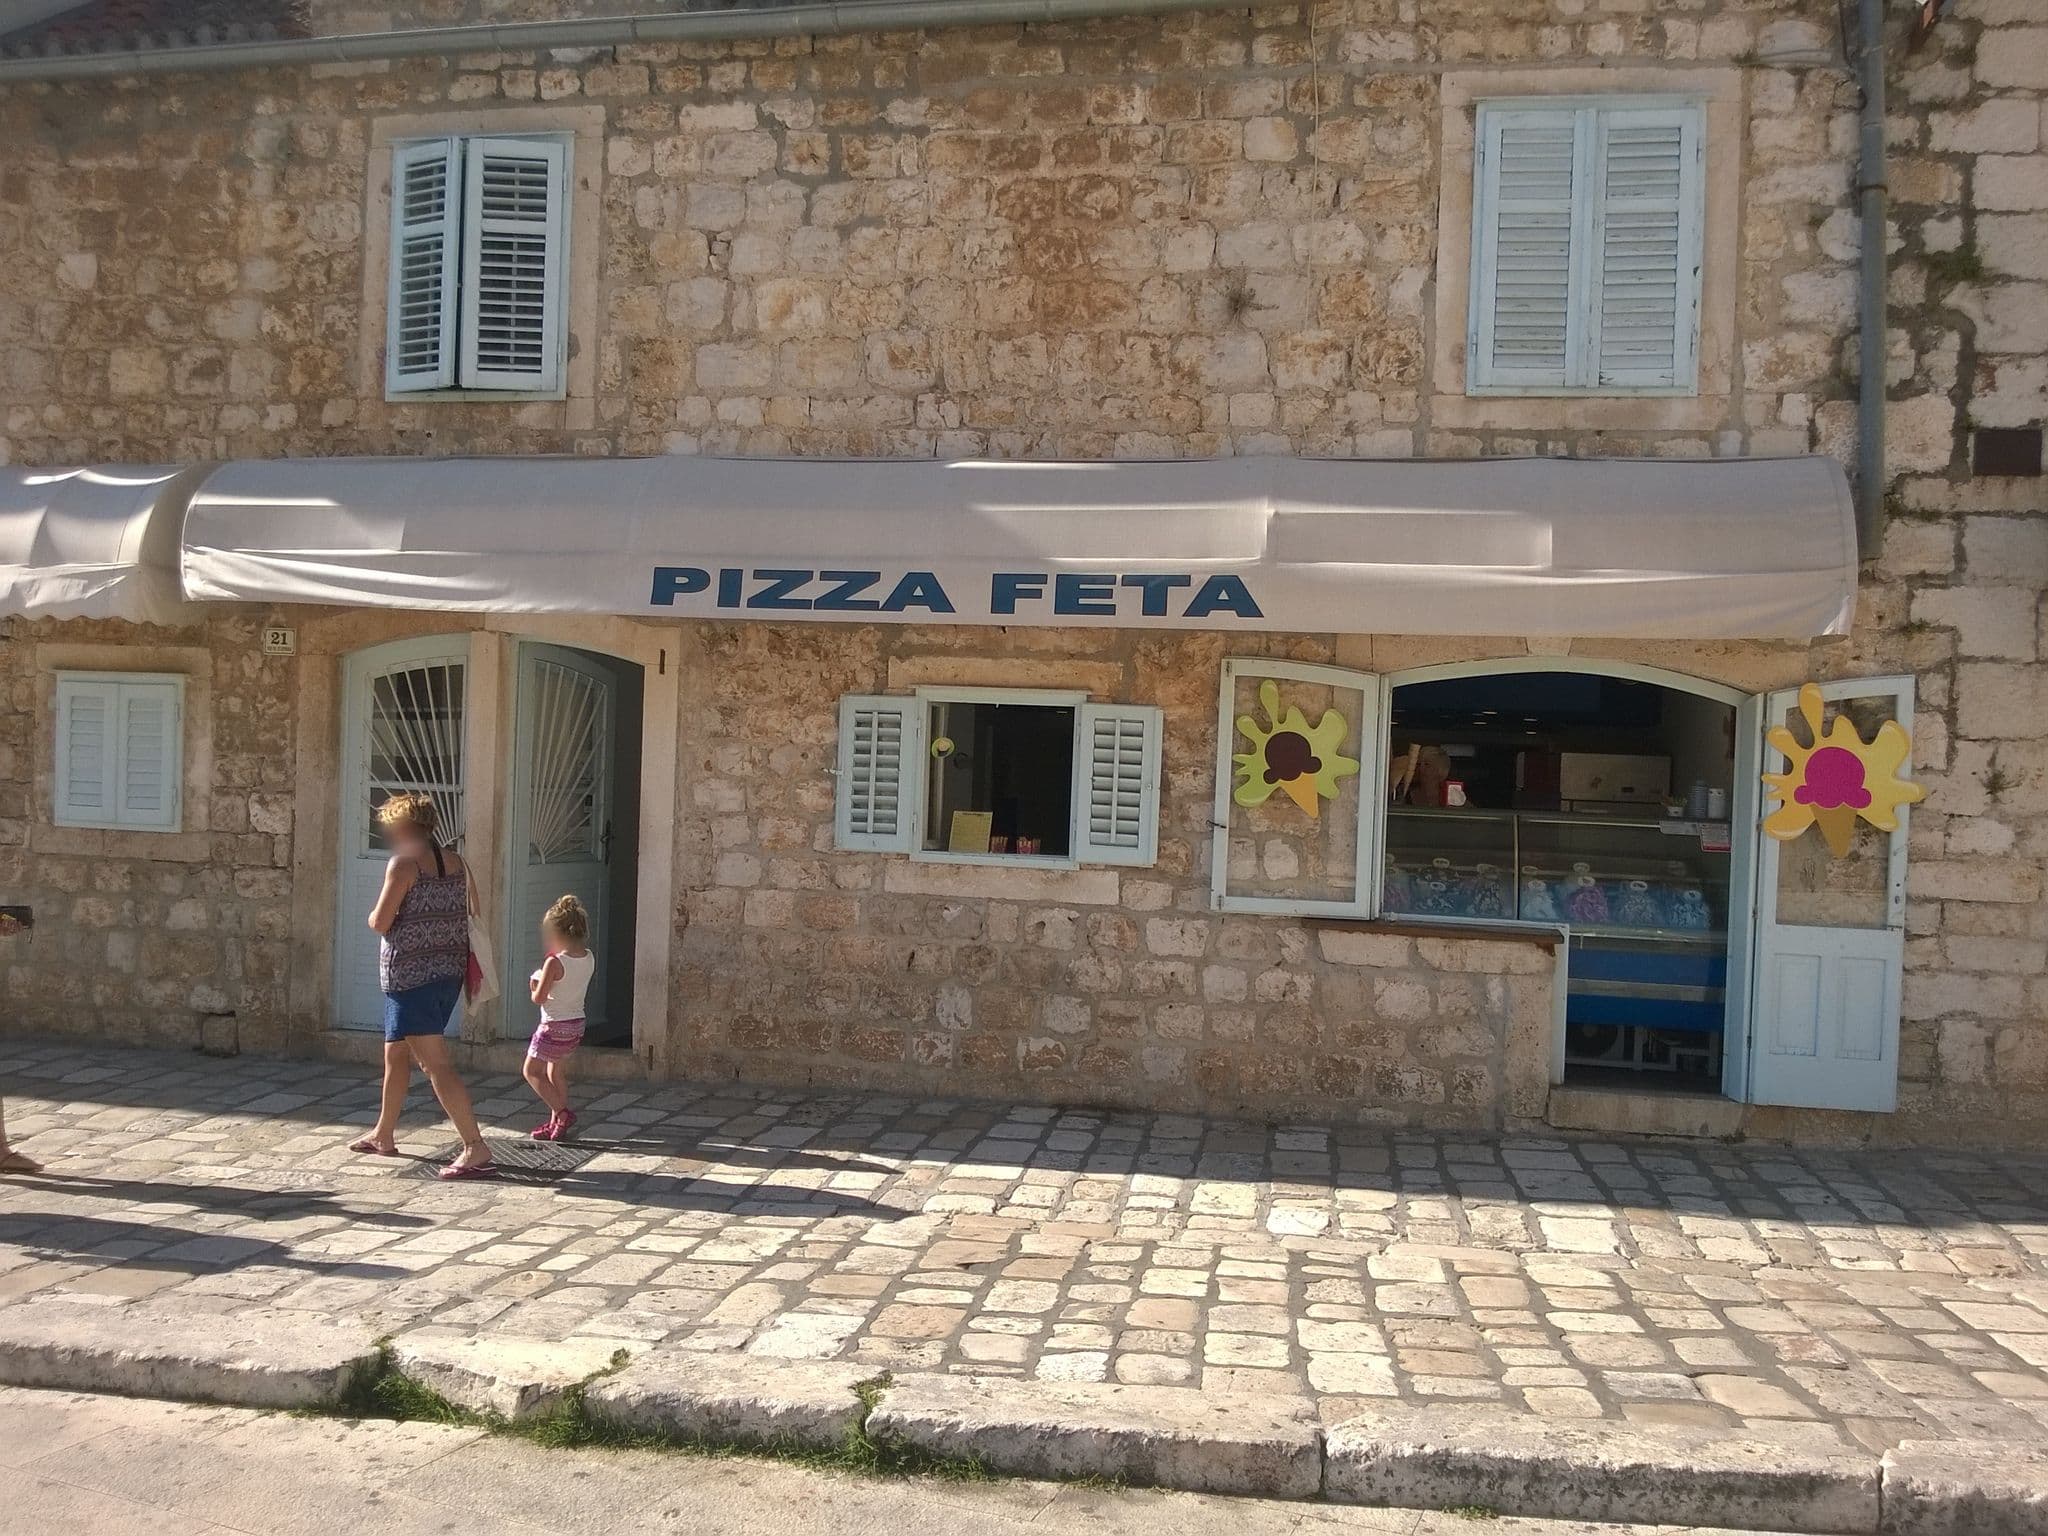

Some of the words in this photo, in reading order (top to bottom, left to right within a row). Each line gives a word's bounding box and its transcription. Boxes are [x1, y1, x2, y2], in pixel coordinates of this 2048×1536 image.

[650, 567, 956, 613] PIZZA
[990, 573, 1264, 618] FETA
[271, 631, 288, 645] 21
